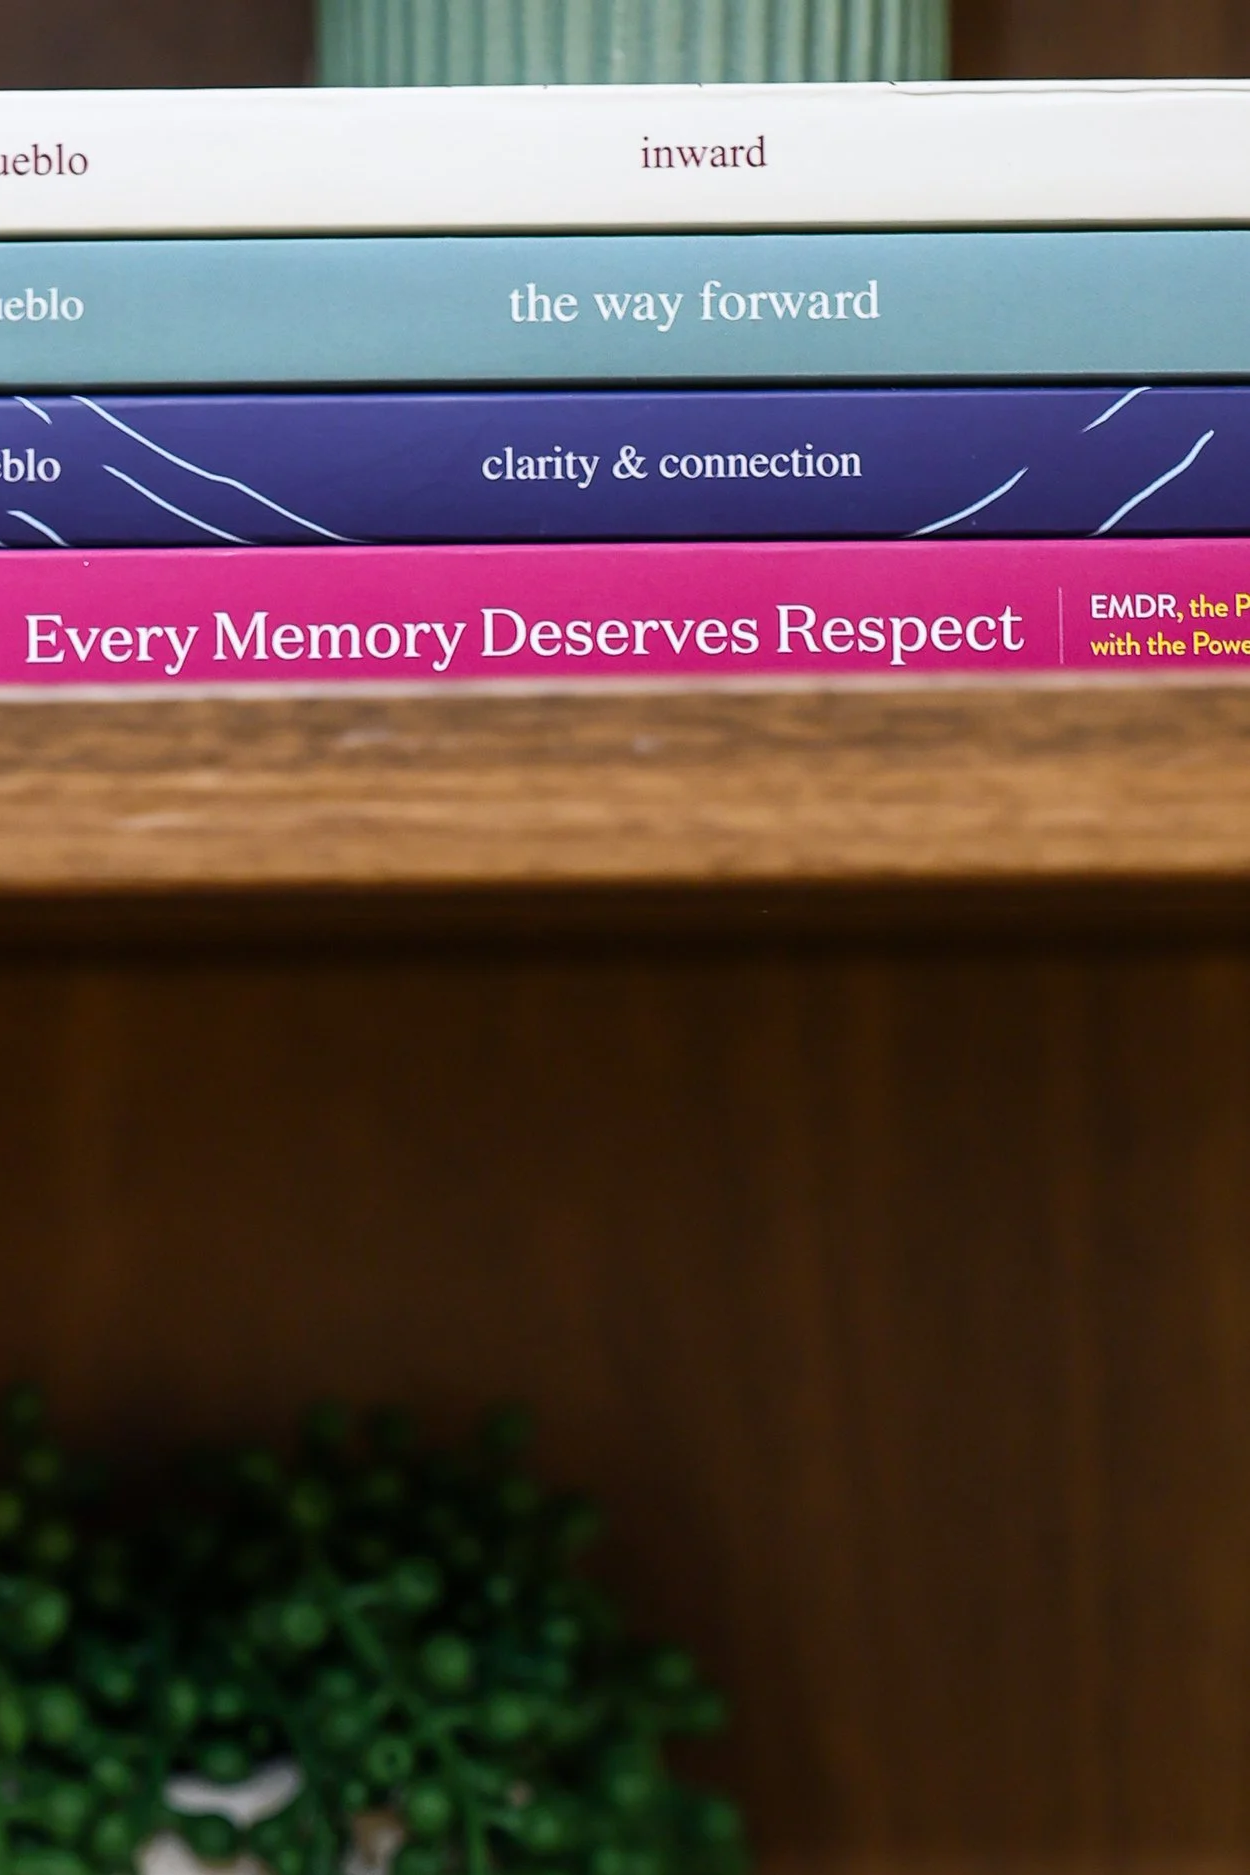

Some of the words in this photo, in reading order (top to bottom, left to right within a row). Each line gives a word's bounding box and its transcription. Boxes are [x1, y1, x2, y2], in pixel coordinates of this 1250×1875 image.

[640, 136, 767, 169] inward
[509, 283, 579, 322] the
[593, 290, 684, 332] way
[699, 280, 881, 321] forward
[481, 446, 600, 490] clarity
[611, 446, 648, 481] &
[658, 443, 863, 480] connection
[1090, 594, 1184, 623] EMDR,
[1189, 594, 1229, 617] the
[25, 613, 198, 676] Every
[213, 611, 466, 672] Memory
[481, 606, 759, 659] Deserves
[775, 602, 1025, 667] Respect
[1090, 632, 1141, 655] with
[1147, 632, 1186, 655] the
